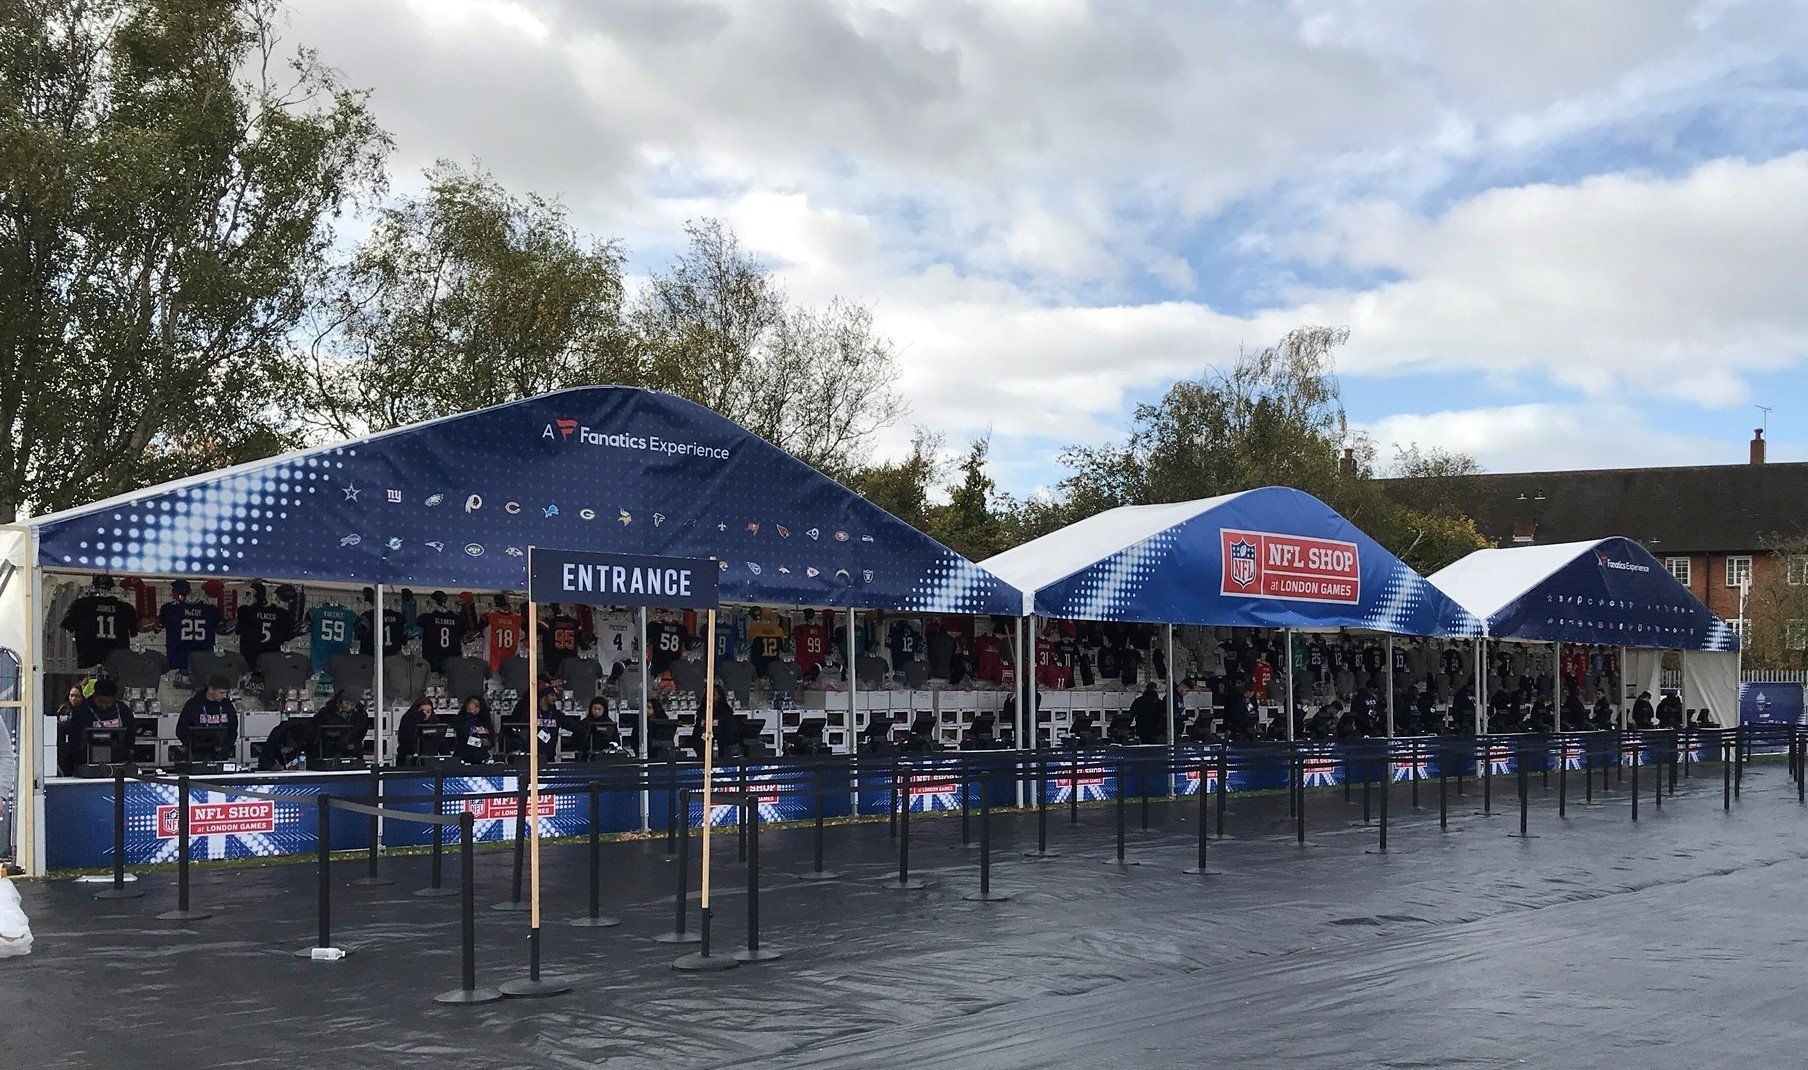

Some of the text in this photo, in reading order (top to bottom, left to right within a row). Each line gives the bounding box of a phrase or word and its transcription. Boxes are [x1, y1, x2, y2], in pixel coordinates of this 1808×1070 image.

[542, 424, 730, 460] A Fanatics Experience
[1269, 544, 1354, 572] NFL SHOP
[1607, 558, 1626, 570] Fanatics
[1626, 561, 1650, 573] Experience
[1233, 558, 1255, 580] NFL
[563, 563, 692, 597] ENTRANCE
[1270, 580, 1352, 597] at LONDON GAMES
[96, 615, 117, 639] 11
[181, 619, 206, 641] 25
[261, 622, 271, 643] 5
[321, 619, 345, 642] 59
[384, 625, 392, 646] 1
[440, 627, 449, 648] 8
[496, 628, 513, 648] 18
[612, 633, 622, 651] 4
[660, 632, 679, 652] 58
[762, 637, 778, 657] 12
[807, 637, 821, 653] 99
[902, 636, 914, 653] 12
[1040, 651, 1050, 666] 31
[493, 796, 517, 806] NFL
[195, 805, 270, 820] NFL SHOP
[165, 819, 180, 831] NF
[206, 823, 238, 832] LONDON
[239, 821, 267, 830] GAMES
